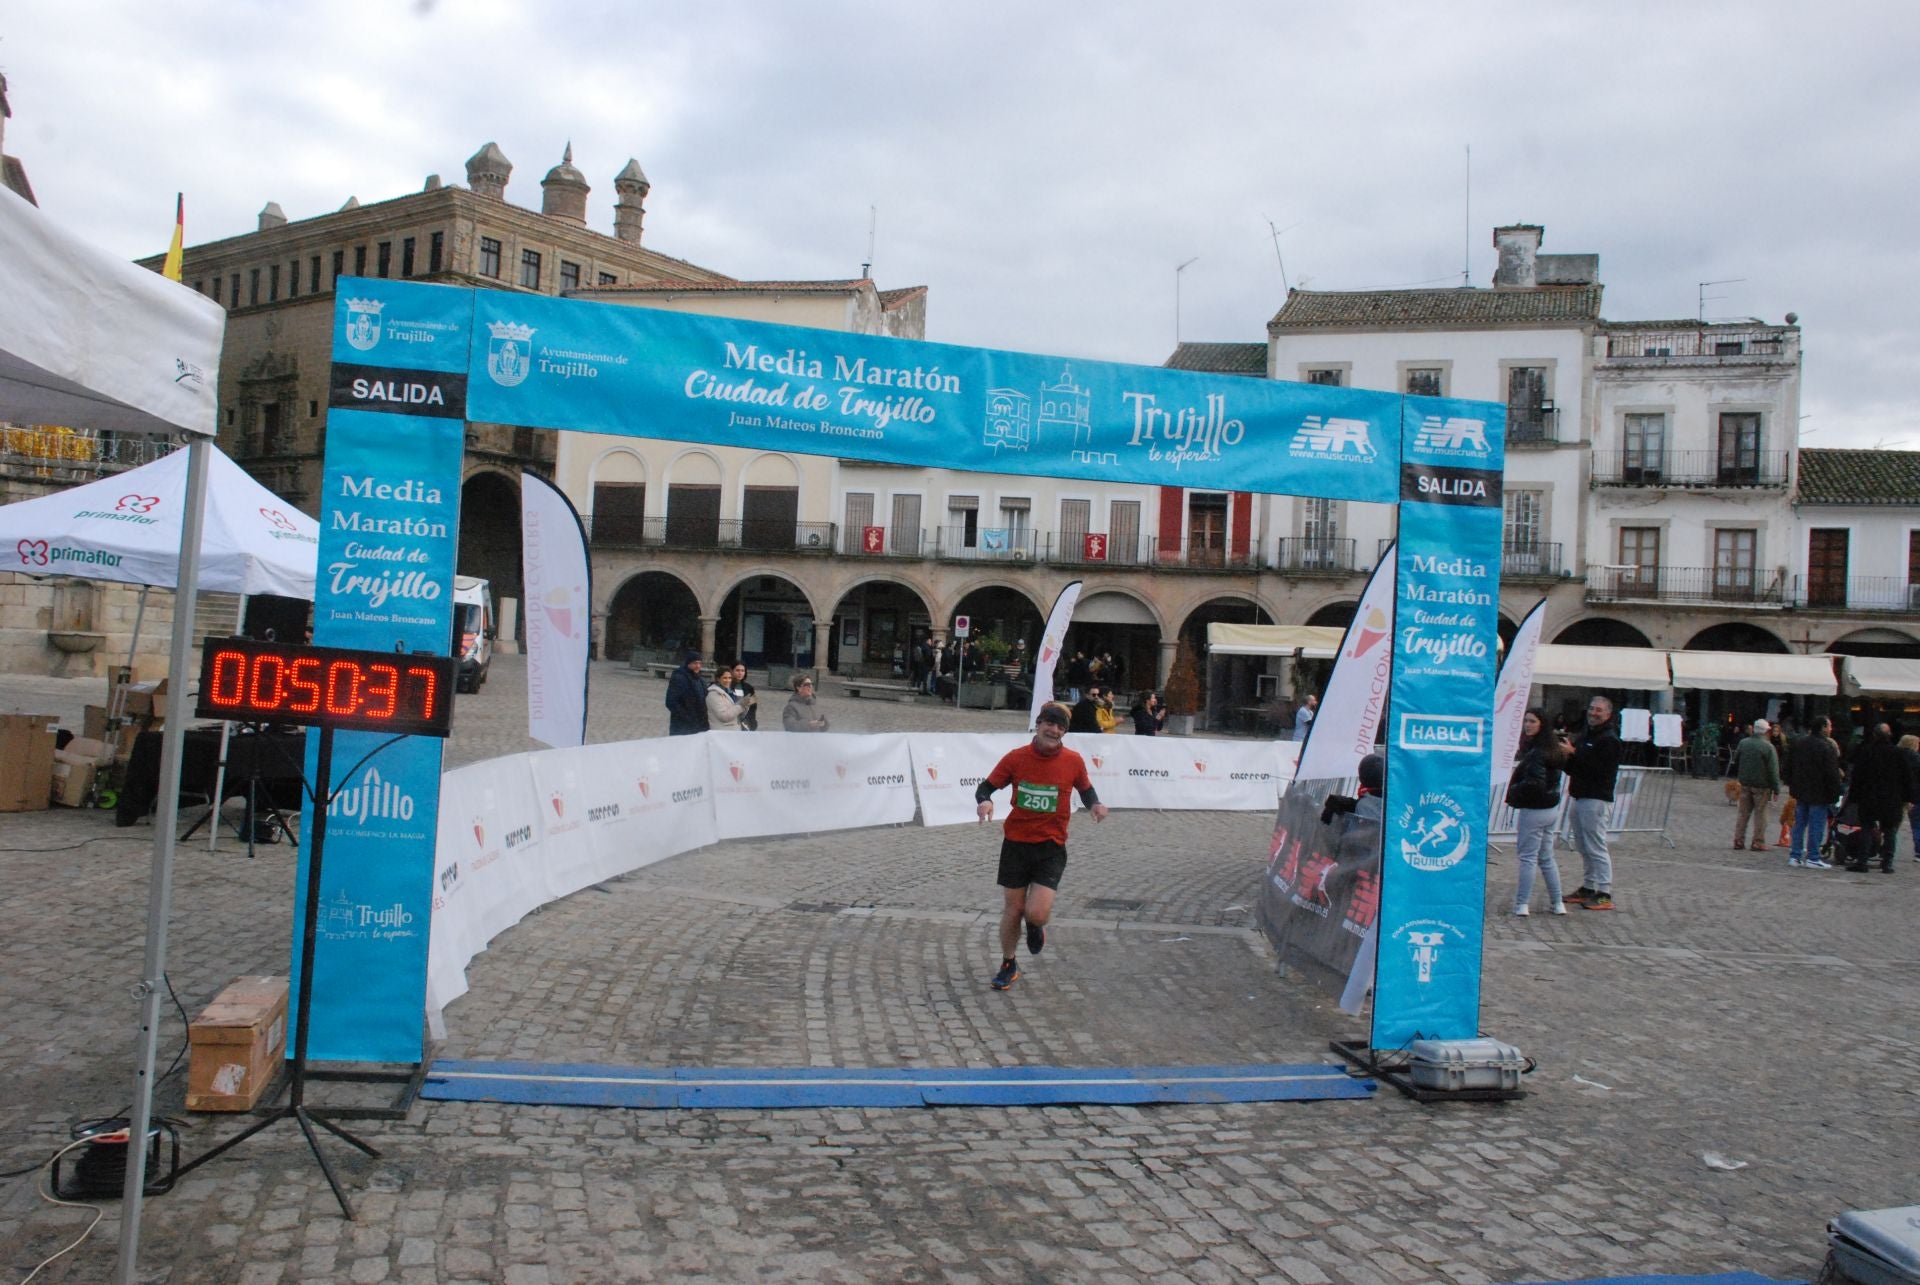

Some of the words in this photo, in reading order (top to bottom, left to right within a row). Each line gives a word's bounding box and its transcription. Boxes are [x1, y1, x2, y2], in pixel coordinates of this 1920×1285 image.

[387, 328, 434, 343] Trujillo
[540, 346, 613, 363] Ayuntamiento
[615, 353, 629, 365] de
[538, 359, 597, 379] Trujillo
[723, 342, 823, 379] Media
[833, 355, 962, 394] Maratón
[351, 378, 444, 405] SALIDA
[684, 369, 789, 405] Ciudad
[793, 385, 831, 411] de
[837, 386, 936, 428] Trujillo
[728, 411, 761, 427] Juan
[766, 416, 816, 432] Mateos
[820, 421, 884, 440] Broncano
[1122, 390, 1245, 456] Trujillo
[1149, 443, 1163, 462] te
[1289, 448, 1374, 464] www.musicrun.es
[340, 475, 442, 504] Media
[1418, 475, 1487, 497] SALIDA
[73, 510, 159, 525] primaflor
[331, 510, 447, 538] Maratón
[50, 546, 123, 568] primaflor
[344, 542, 405, 561] Ciudad
[406, 548, 430, 563] de
[1411, 555, 1486, 577] Media
[328, 562, 441, 608] Trujillo
[1406, 583, 1491, 606] Maratón
[331, 609, 353, 620] Juan
[355, 610, 389, 622] Mateos
[391, 613, 436, 625] Broncano
[1413, 609, 1458, 626] Ciudad
[1460, 613, 1476, 627] de
[1402, 626, 1487, 664] Trujillo
[211, 651, 435, 720] 00:50:37
[1354, 649, 1392, 756] DIPUTACIÓN
[1411, 723, 1471, 742] HABLA
[1024, 794, 1050, 810] 250
[1399, 803, 1414, 829] Club
[1419, 792, 1465, 817] Atletismo
[356, 903, 413, 928] Trujillo
